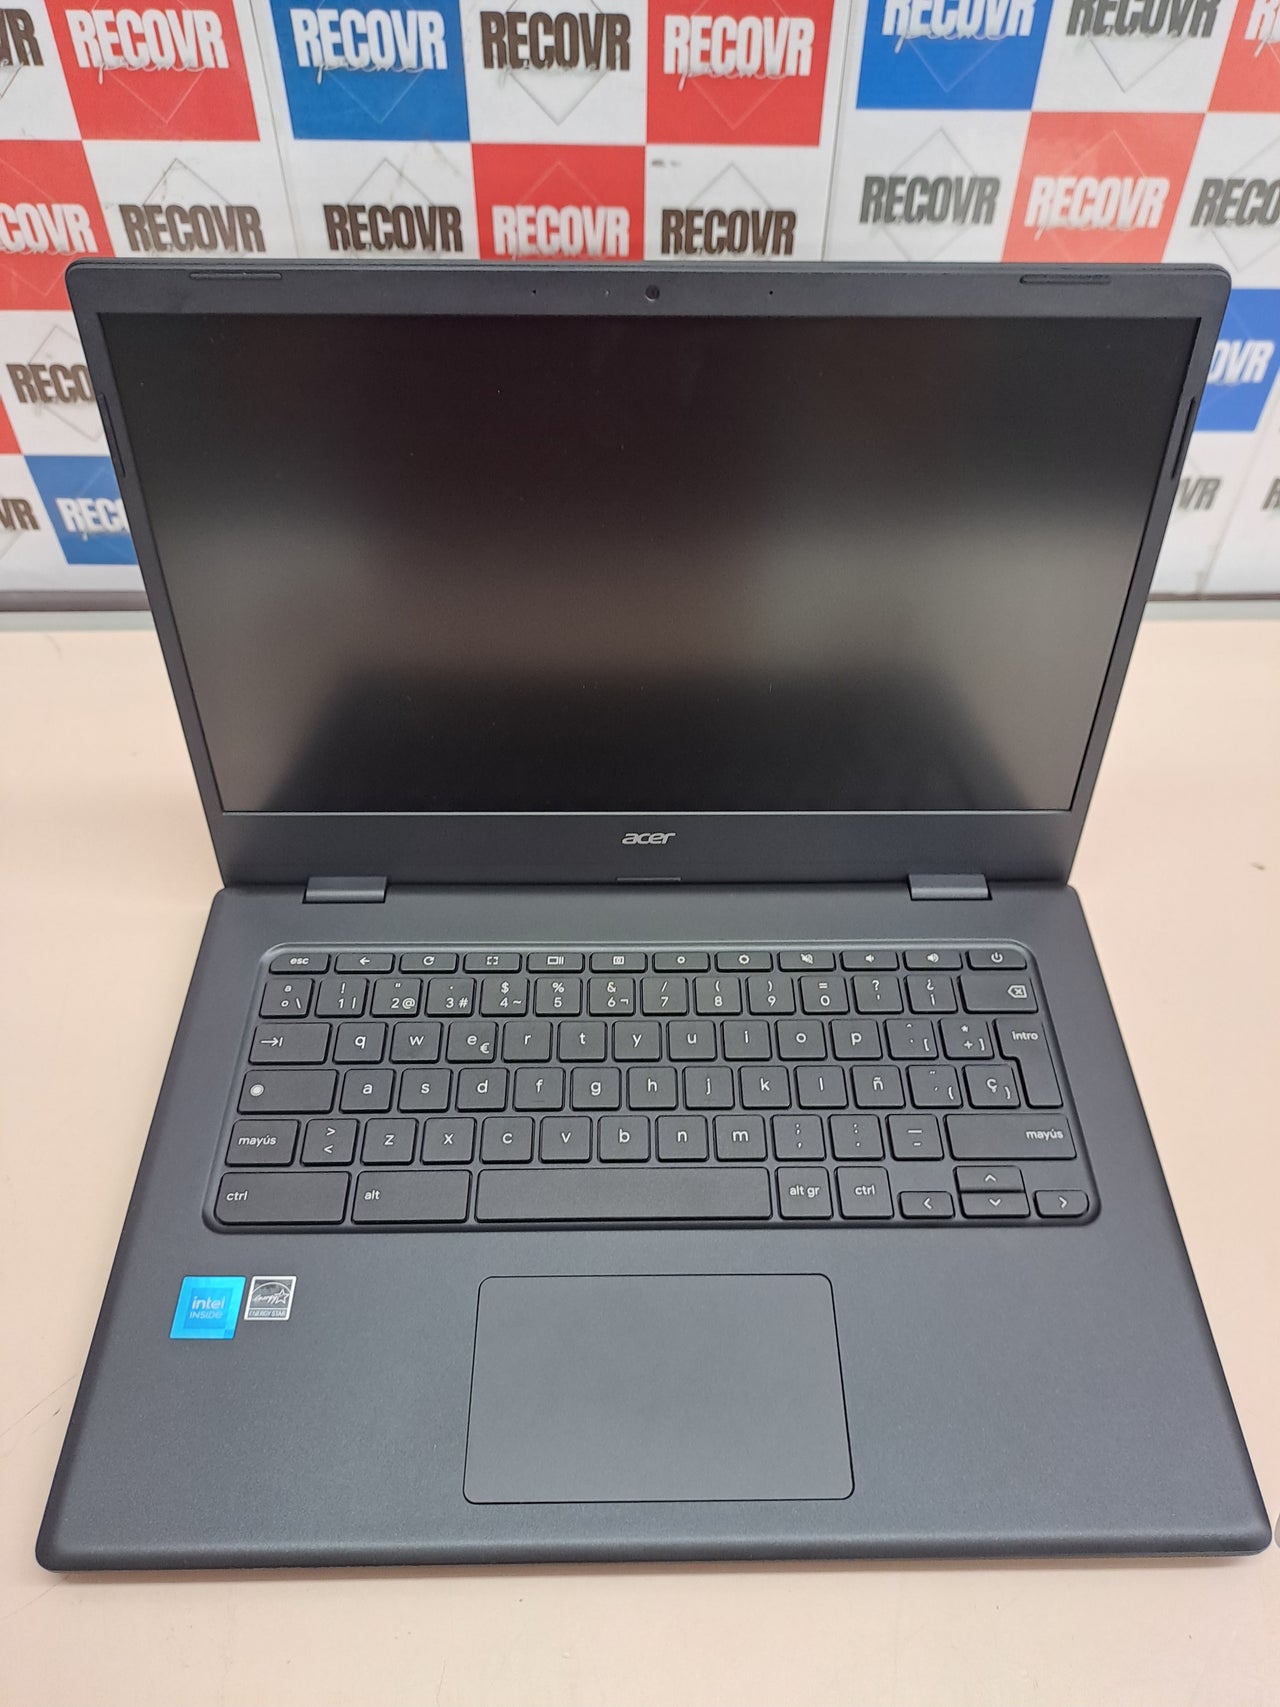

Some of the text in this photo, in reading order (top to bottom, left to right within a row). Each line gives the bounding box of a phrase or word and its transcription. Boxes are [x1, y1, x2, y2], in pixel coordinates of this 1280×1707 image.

[882, 0, 1036, 37] RECOVR
[1066, 0, 1218, 39] RECOVR
[65, 9, 229, 69] RECOVR
[290, 9, 448, 71] RECOVR
[480, 11, 632, 71] RECOVR
[663, 15, 815, 76] RECOVR
[859, 175, 1001, 225] RECOVR
[1024, 176, 1170, 230] RECOVR
[119, 204, 267, 253] RECOVR
[323, 204, 464, 252] RECOVR
[492, 204, 630, 258] RECOVR
[661, 209, 797, 256] RECOVR
[56, 497, 130, 534] REC
[622, 832, 676, 845] acer
[289, 957, 310, 965] esc
[500, 981, 510, 995] $
[552, 982, 565, 993] %
[606, 981, 617, 993] &
[872, 979, 880, 991] ?
[391, 997, 416, 1010] 2 @
[445, 997, 469, 1009] 3 #
[499, 997, 509, 1008] 4
[554, 996, 563, 1008] 5
[607, 996, 616, 1008] 6
[660, 996, 669, 1007] 7
[714, 995, 723, 1007] 8
[767, 995, 776, 1007] 9
[354, 1036, 366, 1049] q
[409, 1036, 424, 1046] w
[467, 1035, 490, 1054] e €
[524, 1034, 532, 1045] r
[579, 1032, 586, 1045] t
[632, 1034, 642, 1048] y
[687, 1033, 697, 1044] u
[795, 1032, 807, 1044] o
[851, 1032, 862, 1046] p
[362, 1083, 373, 1095] a
[421, 1083, 430, 1094] s
[476, 1079, 488, 1094] d
[535, 1079, 544, 1093] f
[590, 1081, 601, 1096] g
[647, 1078, 658, 1092] h
[706, 1078, 711, 1095] j
[760, 1078, 770, 1091] k
[873, 1076, 884, 1091] ñ
[238, 1134, 277, 1148] mayús
[384, 1134, 395, 1146] z
[443, 1133, 454, 1145] x
[502, 1133, 513, 1144] c
[561, 1132, 572, 1143] v
[619, 1128, 630, 1143] b
[677, 1131, 688, 1142] n
[732, 1130, 749, 1142] m
[1025, 1128, 1064, 1141] mayús
[226, 1190, 248, 1201] ctrl
[364, 1189, 380, 1200] alt
[789, 1185, 820, 1198] alt gr
[855, 1184, 876, 1196] ctrl
[191, 1295, 225, 1310] intel
